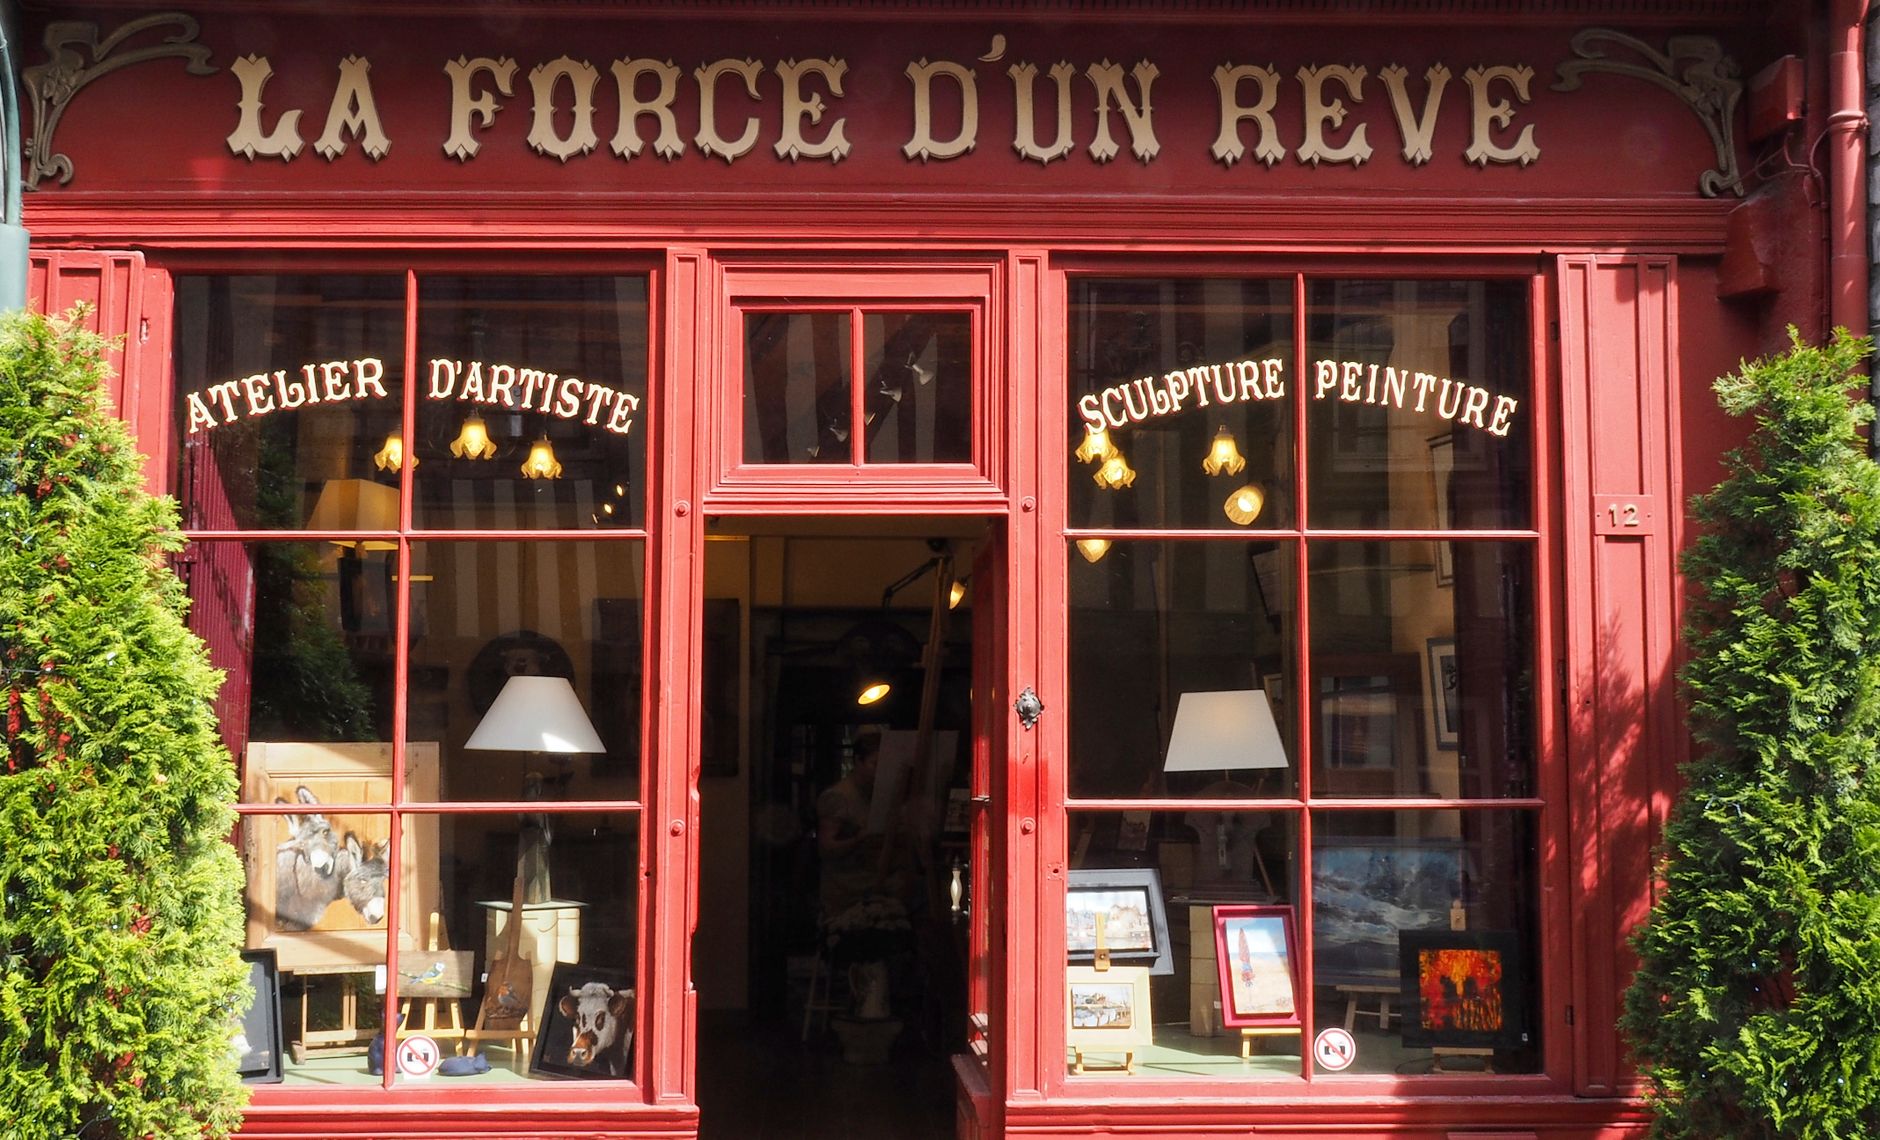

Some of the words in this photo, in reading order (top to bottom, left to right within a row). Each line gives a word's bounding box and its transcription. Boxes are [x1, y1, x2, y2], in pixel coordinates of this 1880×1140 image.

[227, 52, 393, 163] LA
[443, 54, 852, 164] FORCE
[902, 33, 1162, 167] D'UN
[1209, 60, 1542, 170] REVE
[185, 357, 388, 435] ATELIER
[427, 358, 641, 434] D'ARTISTE
[1078, 358, 1286, 435] SCULPTURE
[1313, 359, 1519, 438] PEINTURE
[1608, 503, 1639, 527] 12
